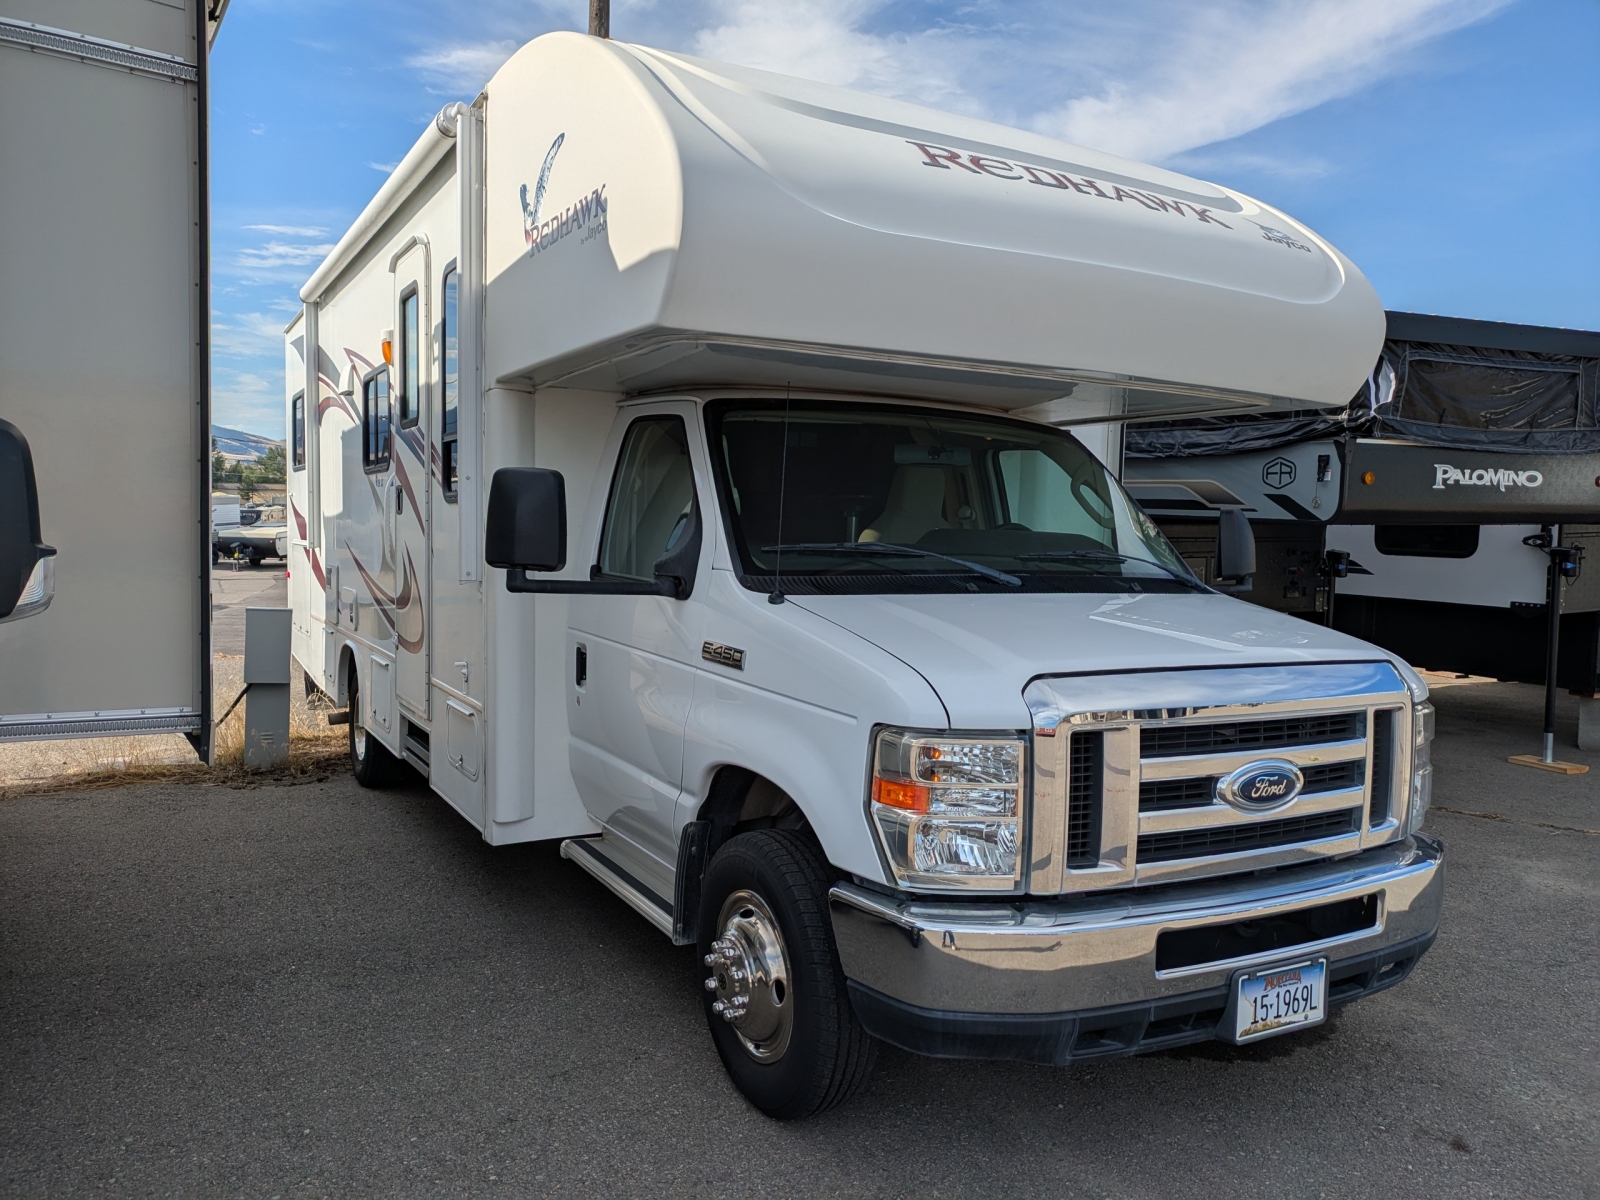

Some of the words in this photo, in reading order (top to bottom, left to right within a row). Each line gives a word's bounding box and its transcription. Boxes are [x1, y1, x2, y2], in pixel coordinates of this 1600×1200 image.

[905, 140, 1234, 230] REDHAWK
[529, 183, 606, 259] REDHAWK
[1262, 231, 1311, 253] Jayco
[1432, 464, 1543, 492] PALOMINO
[1251, 775, 1287, 798] Ford
